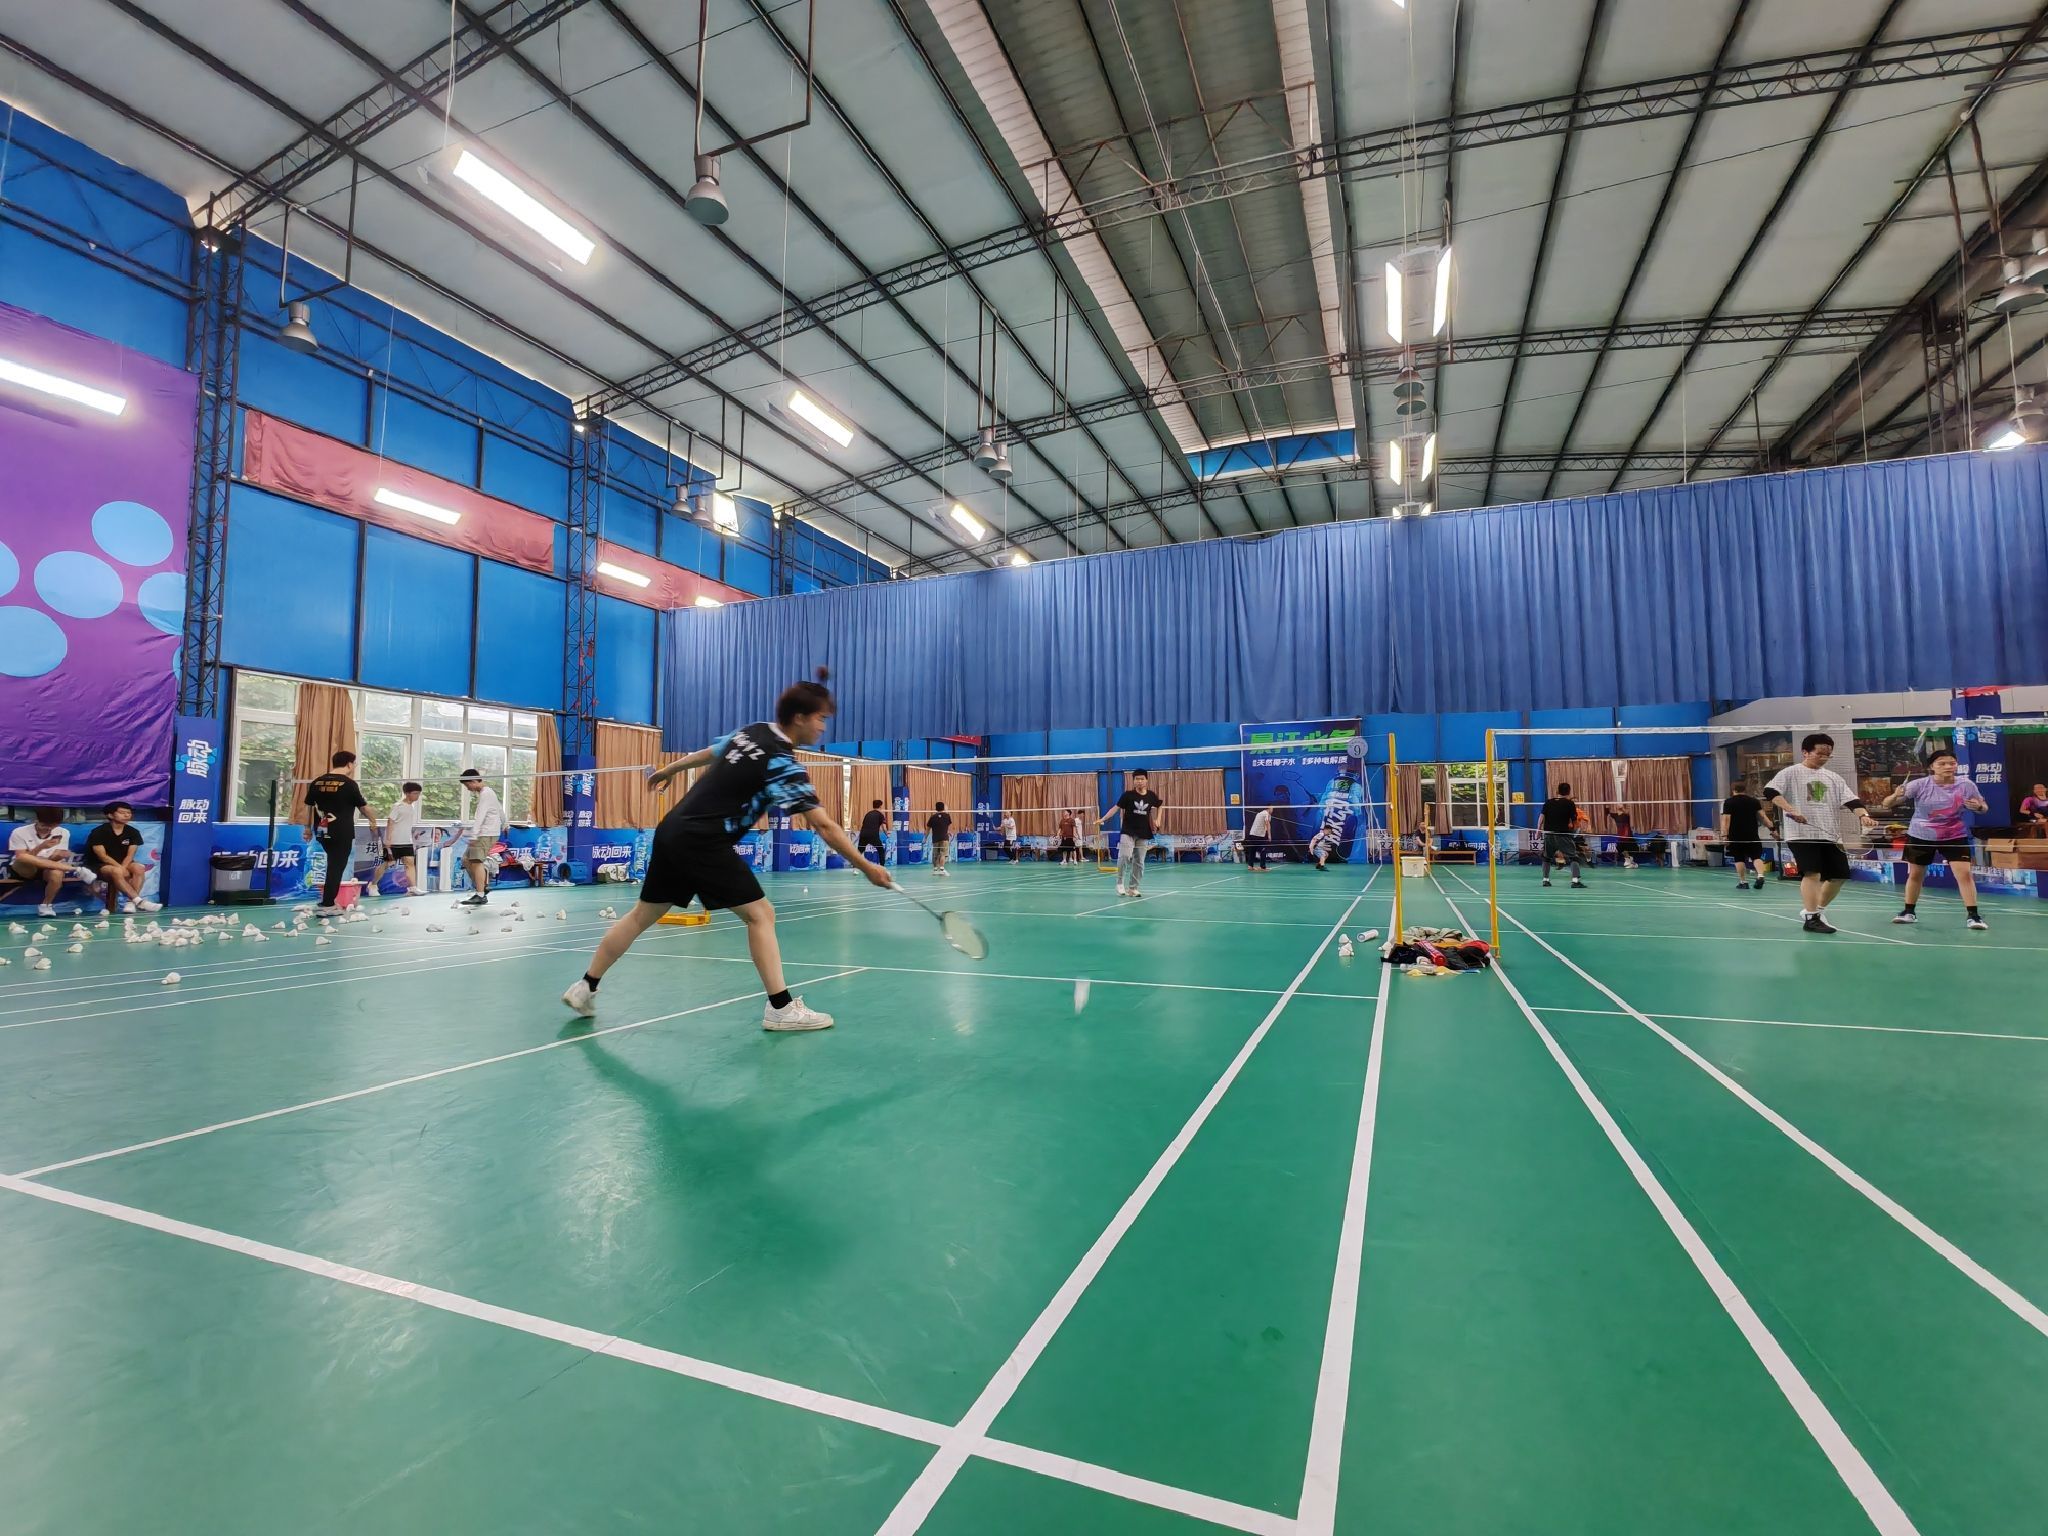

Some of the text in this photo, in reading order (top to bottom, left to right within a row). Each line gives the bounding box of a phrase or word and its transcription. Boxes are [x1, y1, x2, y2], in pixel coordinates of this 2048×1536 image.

[1354, 745, 1361, 755] 9
[186, 739, 213, 777] 脉动
[1976, 763, 2002, 773] 脉动
[1976, 774, 2002, 783] 回来
[179, 799, 209, 809] 脉动
[178, 811, 207, 823] 回来
[592, 845, 632, 861] 脉动回来
[213, 850, 300, 868] 回来
